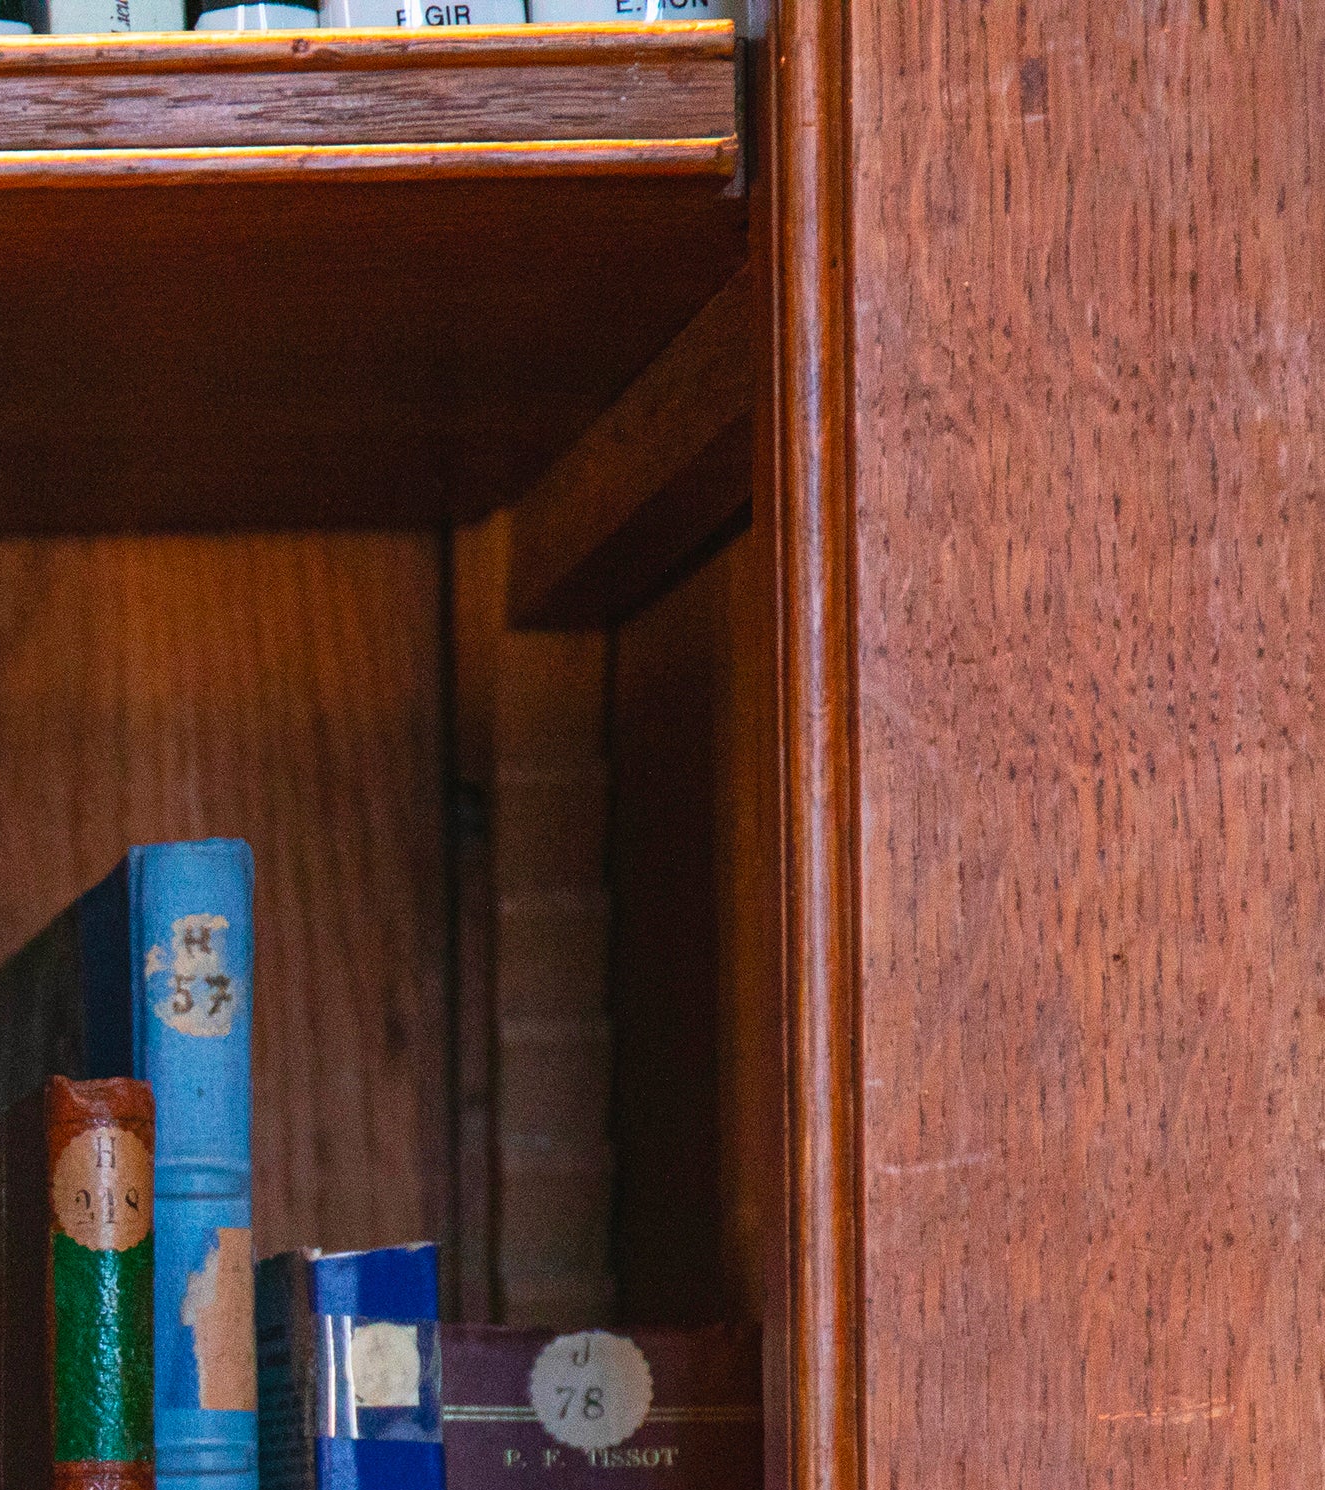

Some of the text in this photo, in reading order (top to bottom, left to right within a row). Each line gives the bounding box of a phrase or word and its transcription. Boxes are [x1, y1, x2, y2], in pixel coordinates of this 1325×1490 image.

[95, 1136, 117, 1170] H
[554, 1385, 606, 1421] 78
[586, 1446, 680, 1469] TISSOT
